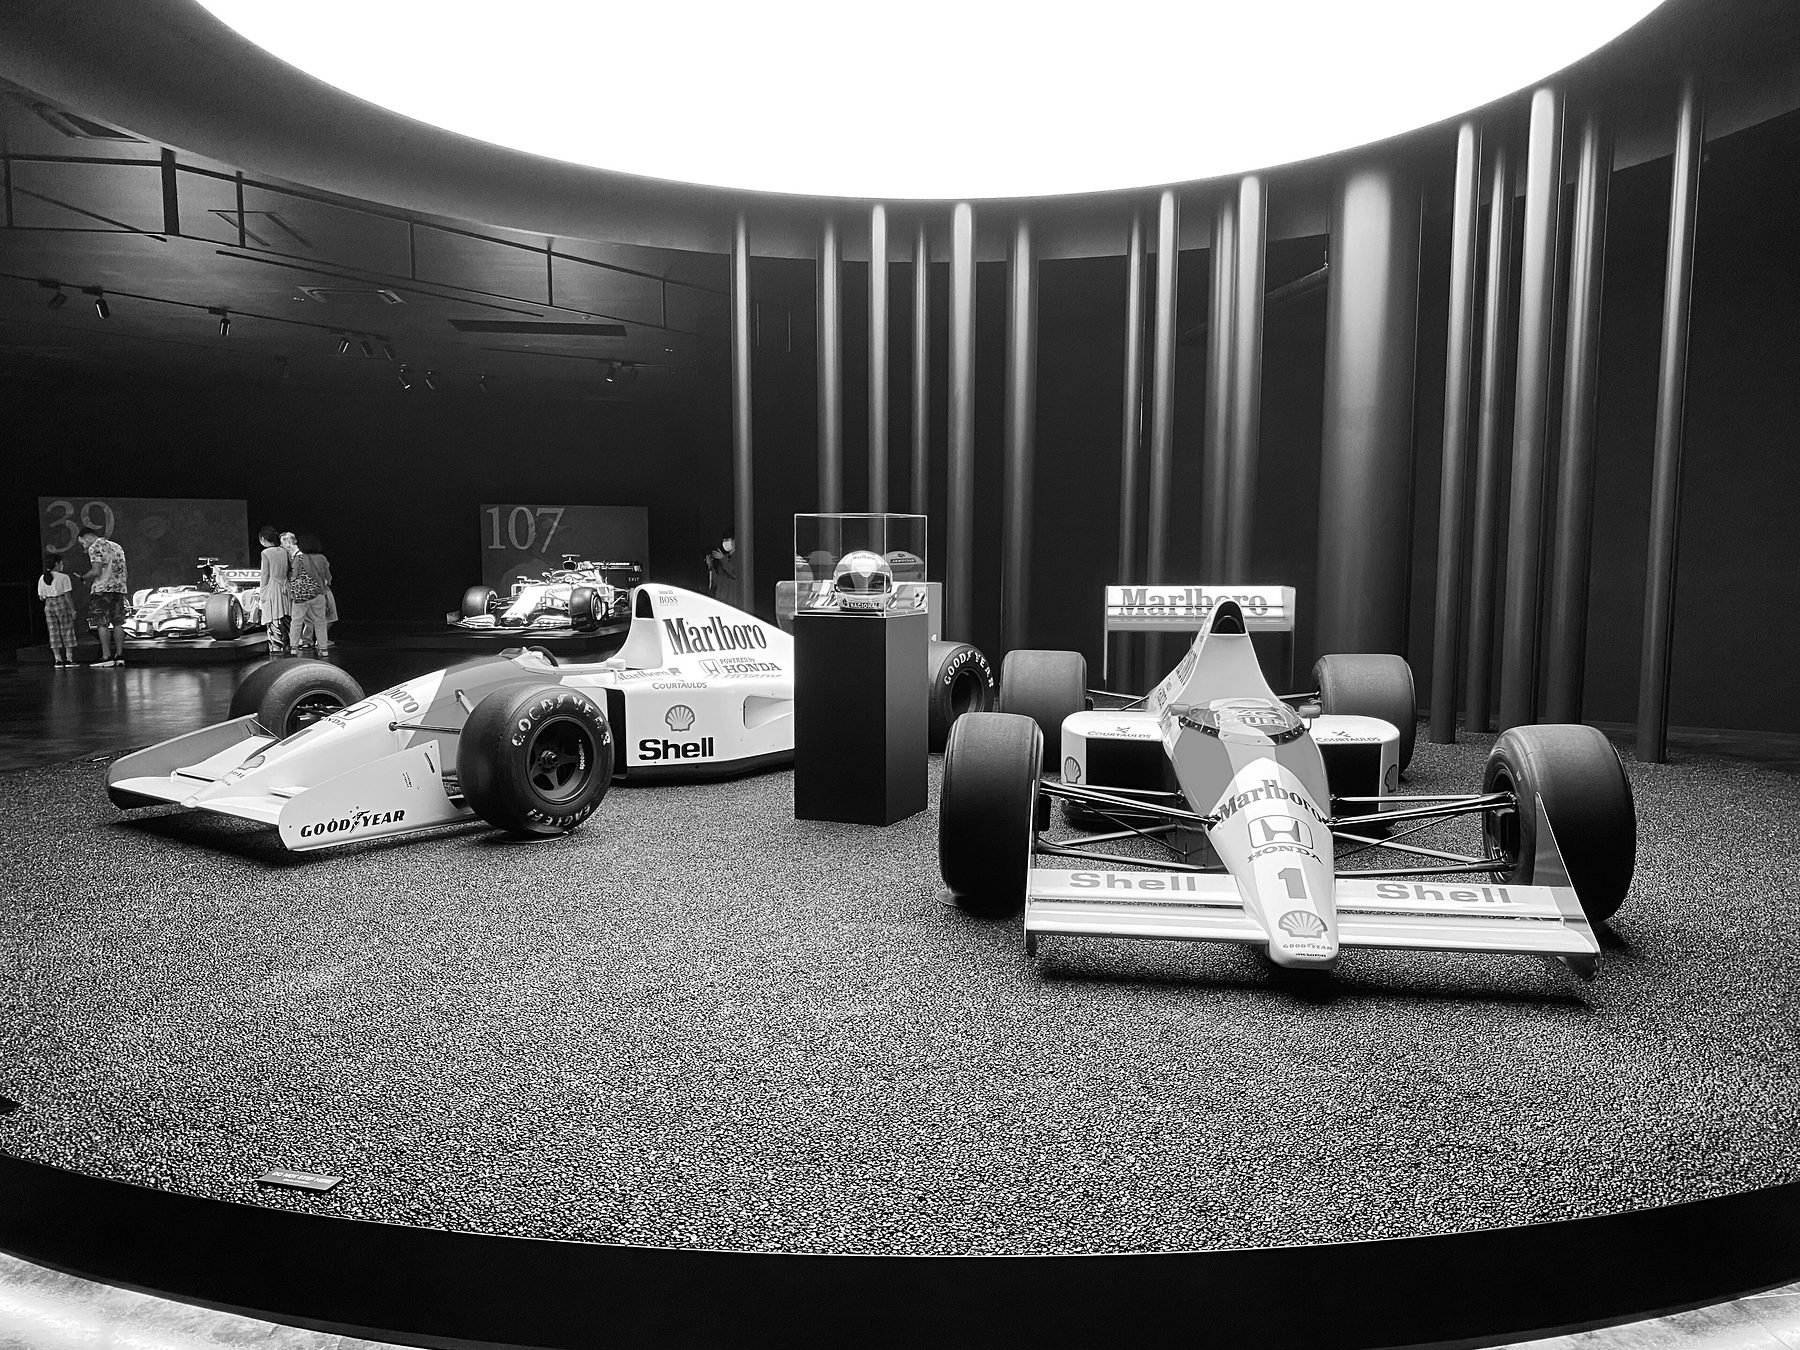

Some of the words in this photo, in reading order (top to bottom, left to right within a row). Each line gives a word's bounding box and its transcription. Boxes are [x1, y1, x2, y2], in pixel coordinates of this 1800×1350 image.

[46, 500, 115, 553] 39
[486, 506, 565, 553] 107
[219, 570, 261, 578] OND
[658, 596, 679, 604] BOSS
[662, 616, 767, 655] Marlboro
[719, 657, 748, 665] POWERED
[723, 662, 783, 674] HONDA
[652, 682, 708, 690] COURTAULDS
[638, 737, 714, 761] Shell
[1219, 780, 1322, 824] Marlboro
[300, 810, 405, 838] GOODYEAR
[1247, 845, 1324, 866] HONDA
[1070, 872, 1196, 891] Shell
[1277, 867, 1307, 899] 1
[1376, 883, 1512, 903] Shell
